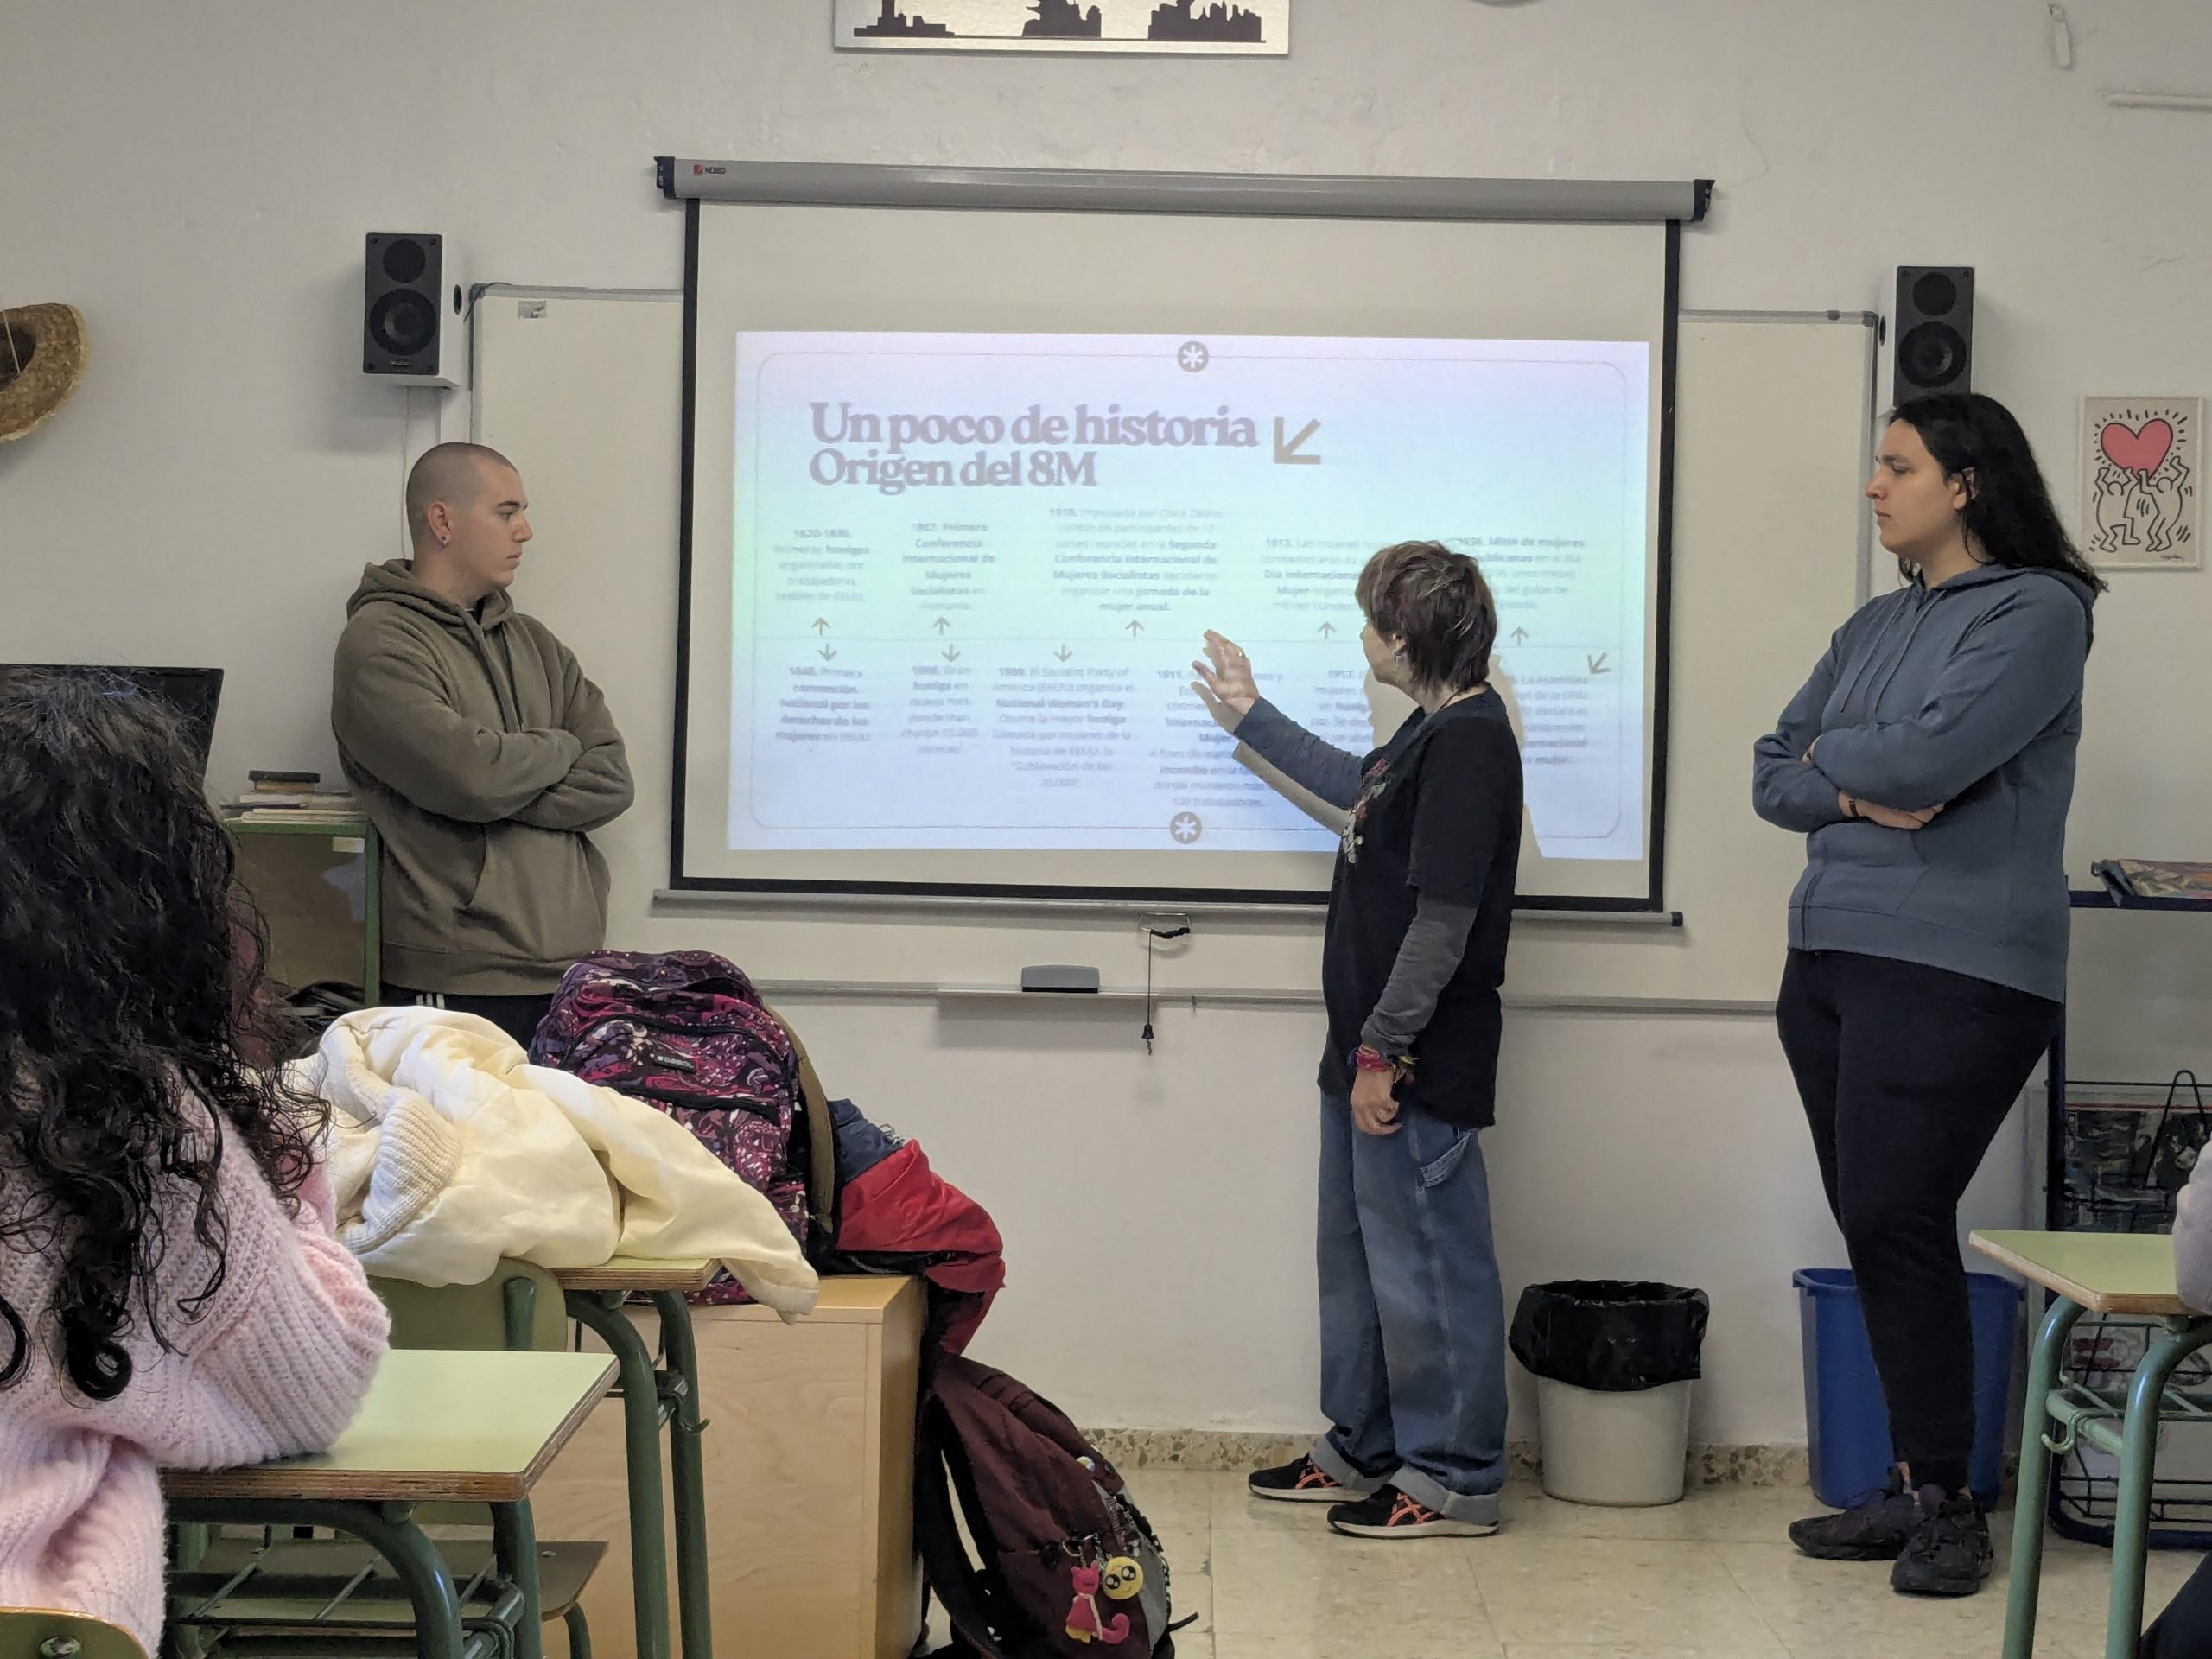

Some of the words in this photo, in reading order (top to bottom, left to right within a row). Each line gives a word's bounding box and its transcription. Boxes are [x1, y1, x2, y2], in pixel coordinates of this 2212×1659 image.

[810, 402, 881, 444] Un
[887, 413, 1004, 454] poco
[1011, 404, 1068, 446] de
[1074, 404, 1258, 447] historia
[810, 448, 955, 495] Origen
[960, 450, 1021, 486] del
[1027, 450, 1097, 487] 8M
[916, 539, 983, 548] Conferencia
[1169, 541, 1217, 551] Segunda
[1538, 537, 1584, 548] mujeres
[903, 555, 978, 563] Internacional
[982, 555, 995, 563] de
[1054, 555, 1122, 564] Conferencia
[1126, 555, 1200, 564] Internacional
[1203, 555, 1217, 564] de
[926, 570, 971, 581] Mujeres
[1053, 570, 1098, 581] Mujeres
[1101, 570, 1160, 580] Socialistas
[911, 587, 969, 595] Socialistas
[1136, 588, 1179, 598] jornada
[1182, 588, 1197, 596] de
[1199, 588, 1210, 596] la
[1099, 603, 1132, 613] mujer
